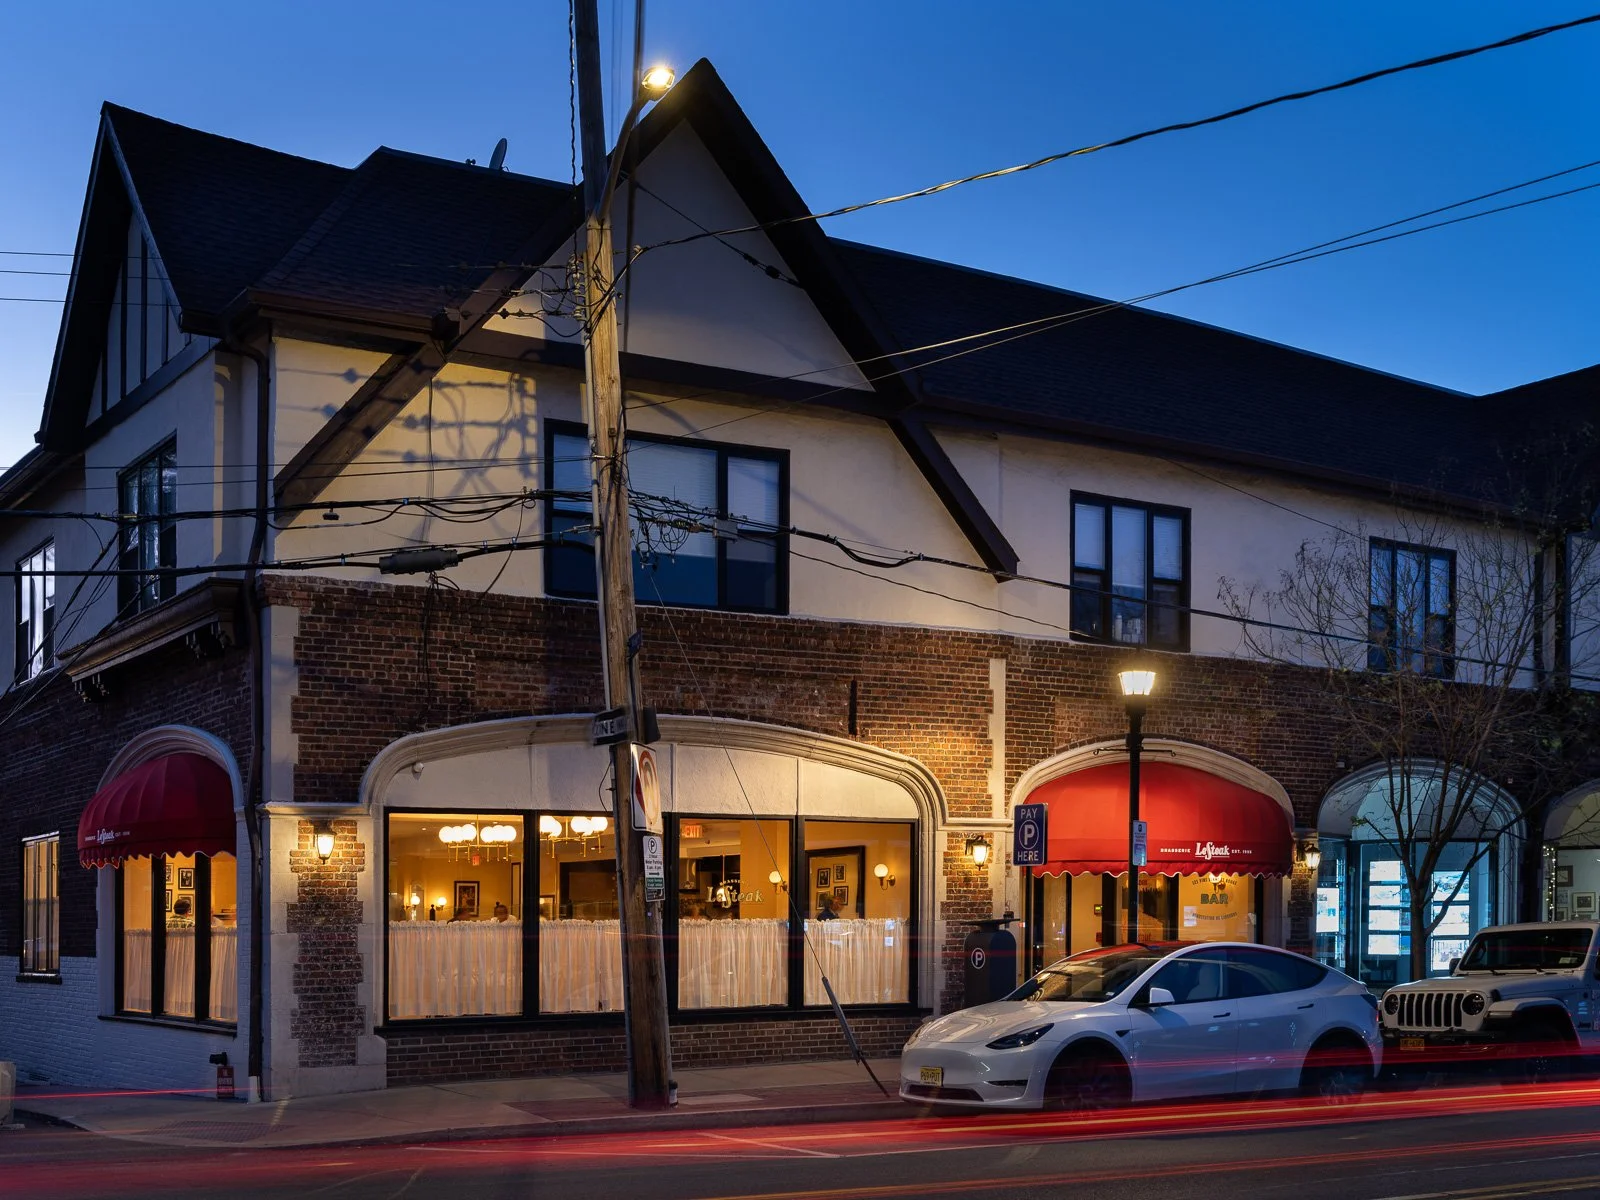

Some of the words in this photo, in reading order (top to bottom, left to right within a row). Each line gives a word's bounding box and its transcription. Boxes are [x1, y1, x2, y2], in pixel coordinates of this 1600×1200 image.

[1020, 808, 1038, 819] PAY
[684, 825, 700, 838] EXIT
[1024, 824, 1035, 846] P
[1017, 850, 1039, 862] HERE
[1195, 841, 1230, 860] LeSteak
[705, 885, 764, 908] LeSteak
[1200, 893, 1229, 905] BAR
